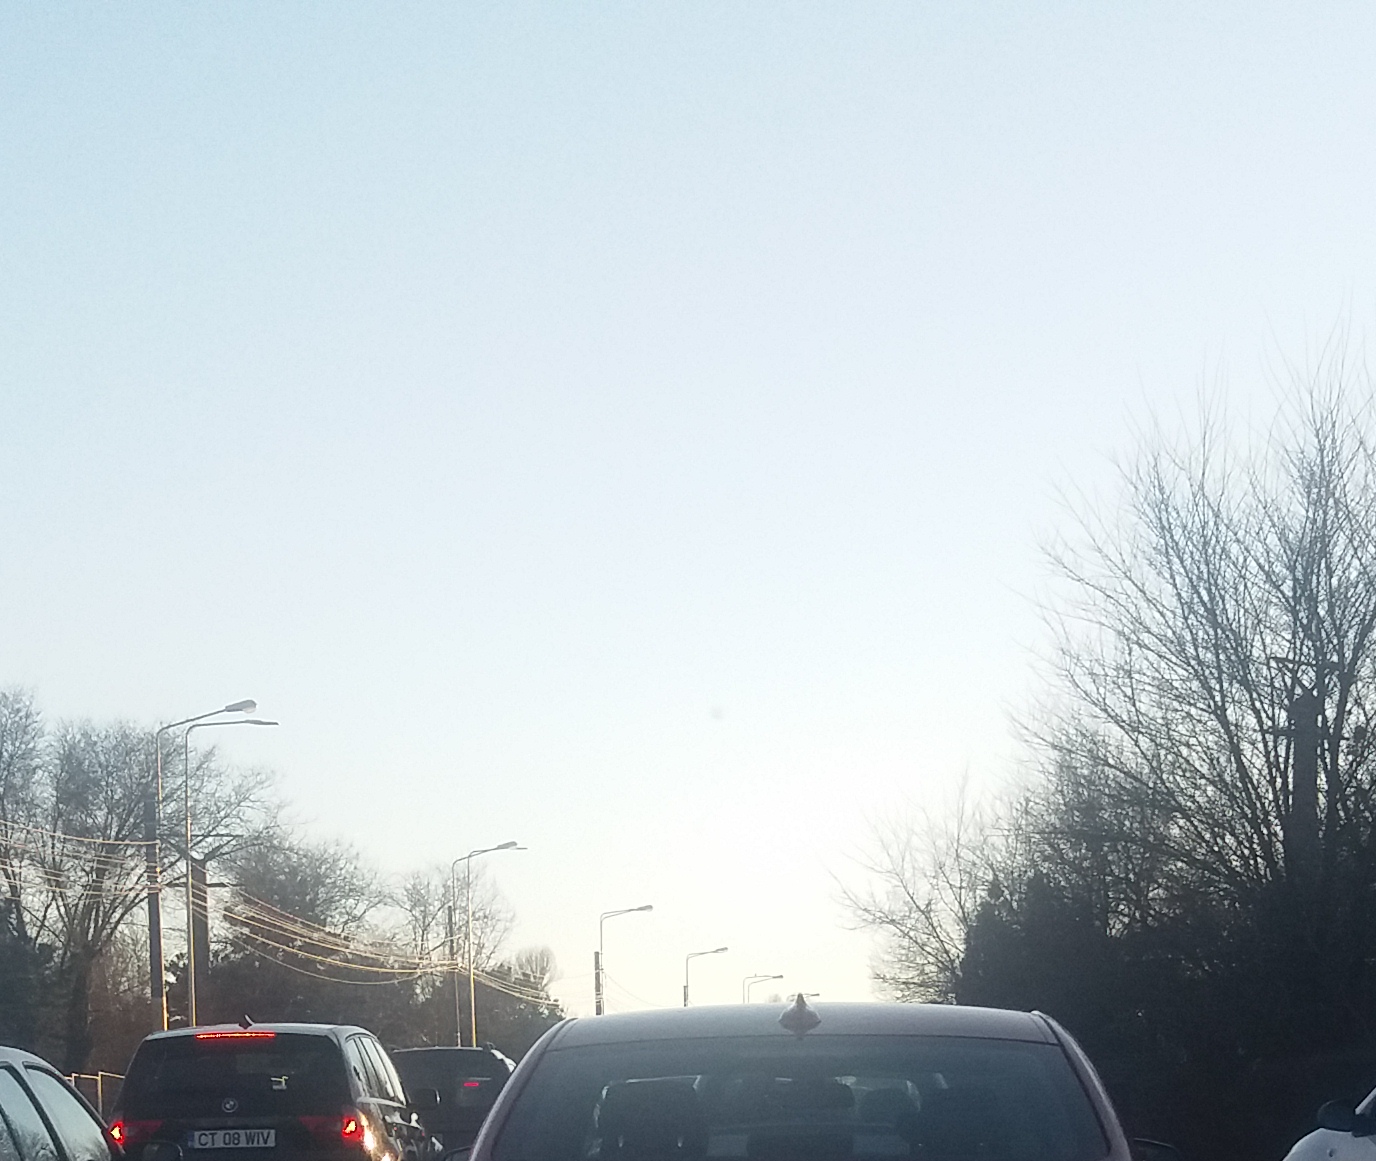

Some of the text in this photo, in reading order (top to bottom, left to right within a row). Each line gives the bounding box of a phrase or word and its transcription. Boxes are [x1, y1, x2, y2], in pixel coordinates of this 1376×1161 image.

[198, 1131, 271, 1147] CT 08 WIV
